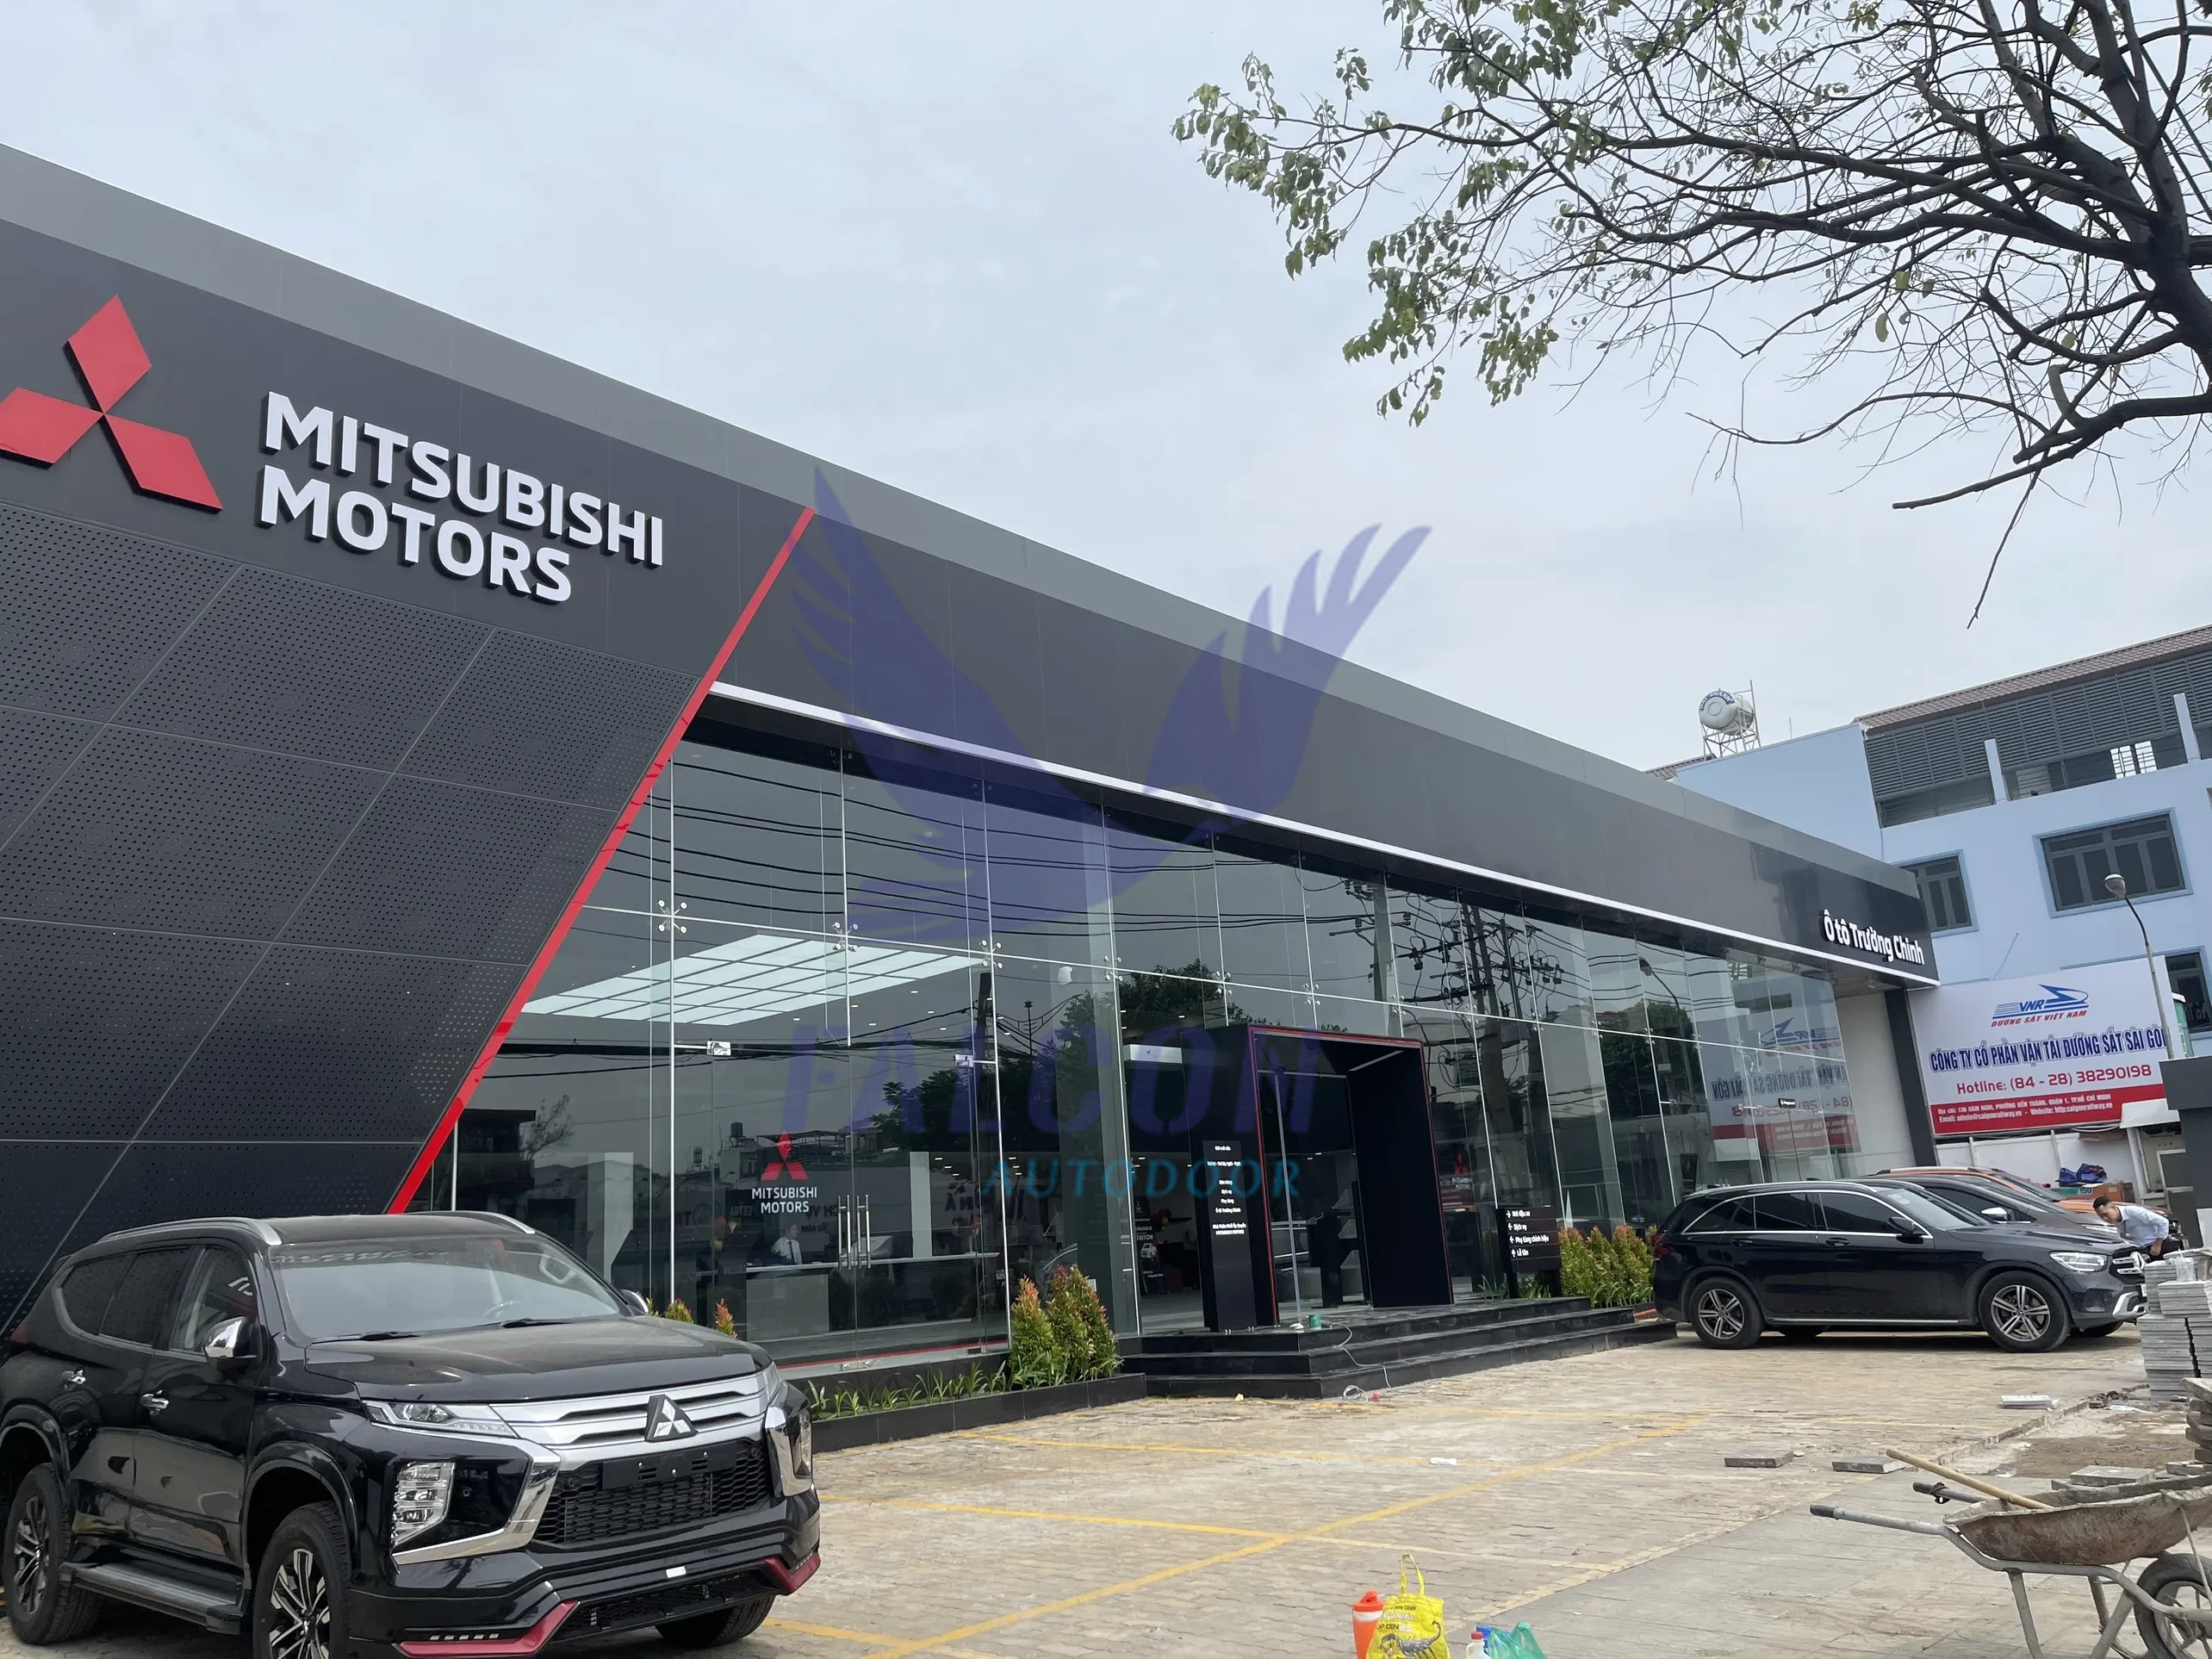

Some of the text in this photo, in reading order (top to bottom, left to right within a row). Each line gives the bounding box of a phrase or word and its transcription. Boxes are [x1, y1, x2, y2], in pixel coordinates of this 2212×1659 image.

[262, 390, 662, 568] MITSUBISHI
[259, 464, 571, 604] MOTORS
[1824, 909, 1925, 965] Ô tô Trường Chinh
[2019, 999, 2045, 1012] VNR
[2066, 1010, 2087, 1018] NAM
[1929, 1047, 1959, 1072] CÔNG
[1959, 1049, 1973, 1069] TY
[1973, 1040, 1989, 1067] CỔ
[1990, 1038, 2019, 1066] PHẦN
[2019, 1039, 2043, 1066] VẬN
[2042, 1035, 2062, 1060] TẢI
[2063, 1033, 2101, 1058] ĐƯỜNG
[2102, 1027, 2123, 1053] SẮT
[2124, 1027, 2145, 1051] SÀI
[1956, 1080, 2007, 1094] Hotline:
[2010, 1076, 2035, 1091] (84
[2048, 1072, 2072, 1086] 28)
[2077, 1065, 2152, 1083] 38290198
[2030, 1107, 2054, 1115] Website:
[751, 1187, 817, 1199] MITSUBISHI
[761, 1201, 810, 1214] MOTORS
